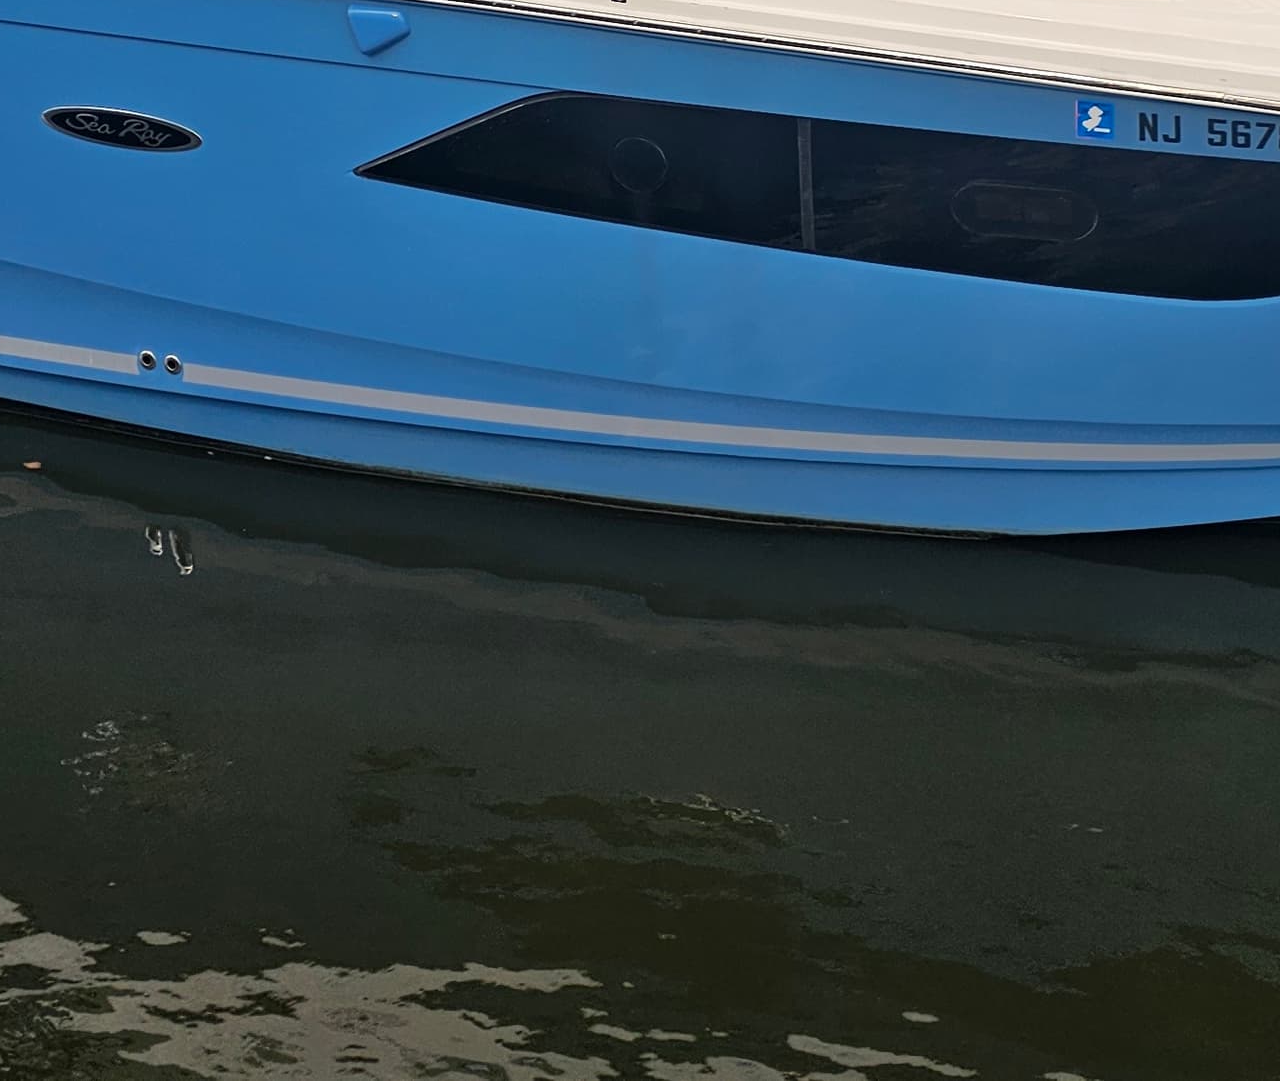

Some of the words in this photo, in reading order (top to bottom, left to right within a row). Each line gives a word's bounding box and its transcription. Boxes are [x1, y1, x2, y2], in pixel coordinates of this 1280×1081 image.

[65, 113, 116, 135] Sea
[119, 118, 173, 147] Ray
[1138, 112, 1182, 144] NJ
